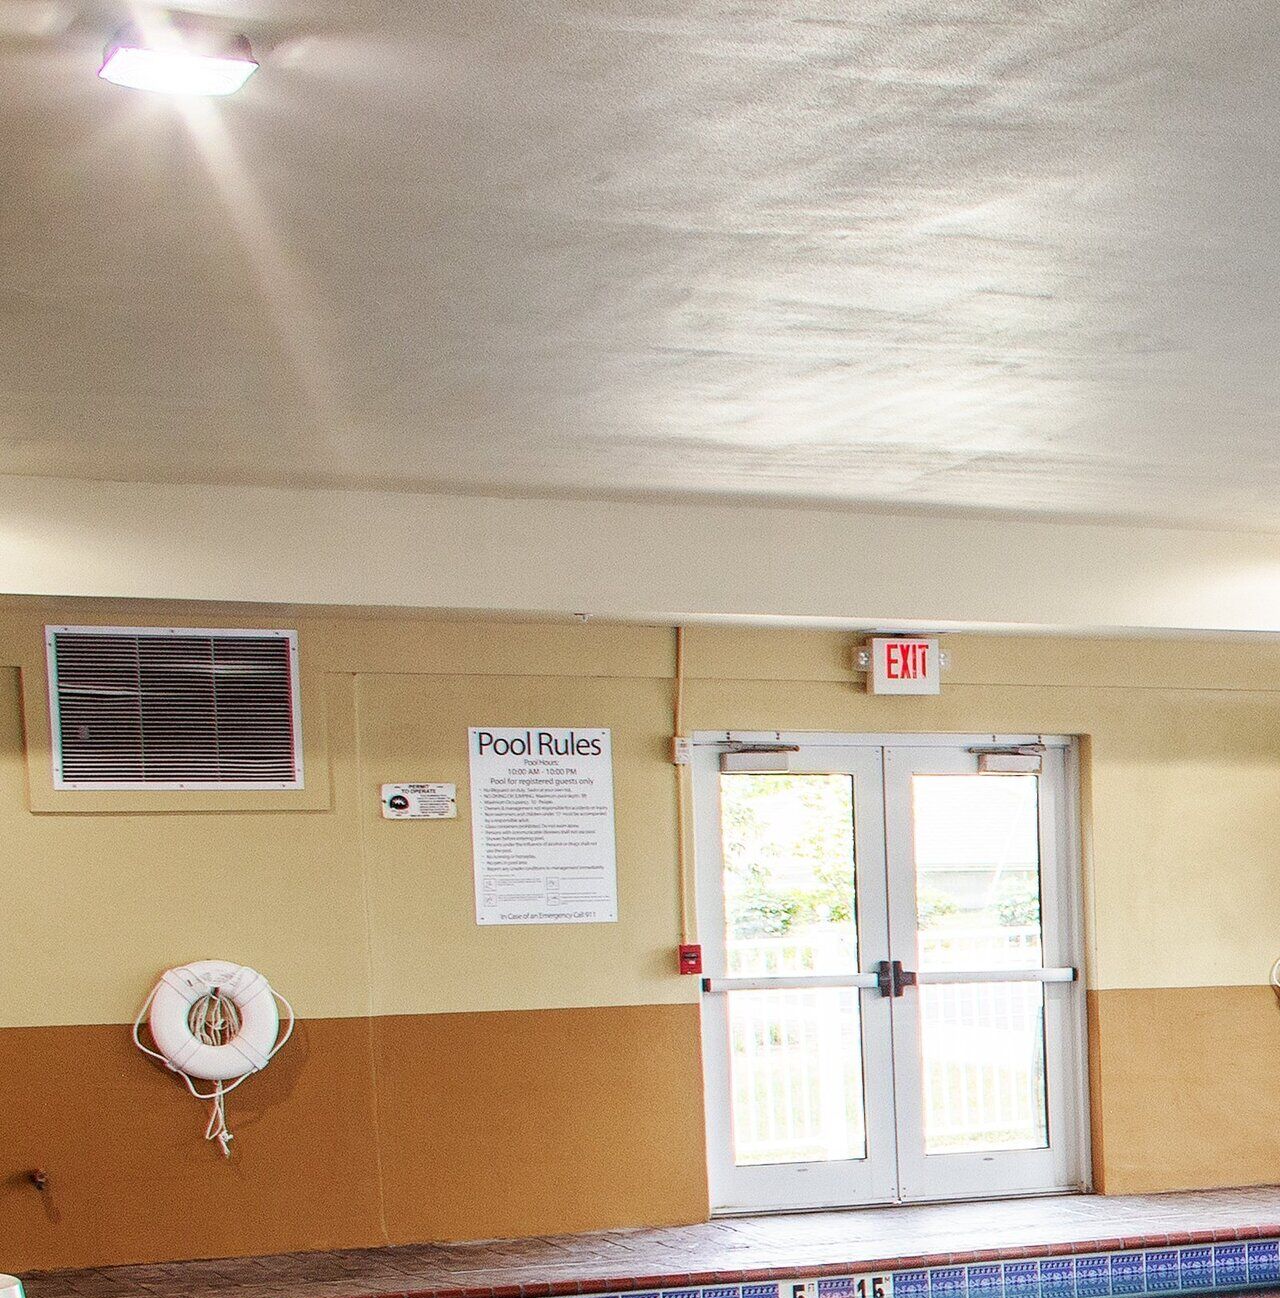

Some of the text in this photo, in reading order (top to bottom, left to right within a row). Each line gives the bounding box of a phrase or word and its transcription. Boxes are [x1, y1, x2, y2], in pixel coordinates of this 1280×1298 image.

[887, 644, 929, 678] EXIT
[479, 731, 602, 756] Pool Rules
[519, 778, 553, 786] registered
[555, 778, 577, 787] guests
[579, 778, 593, 786] only
